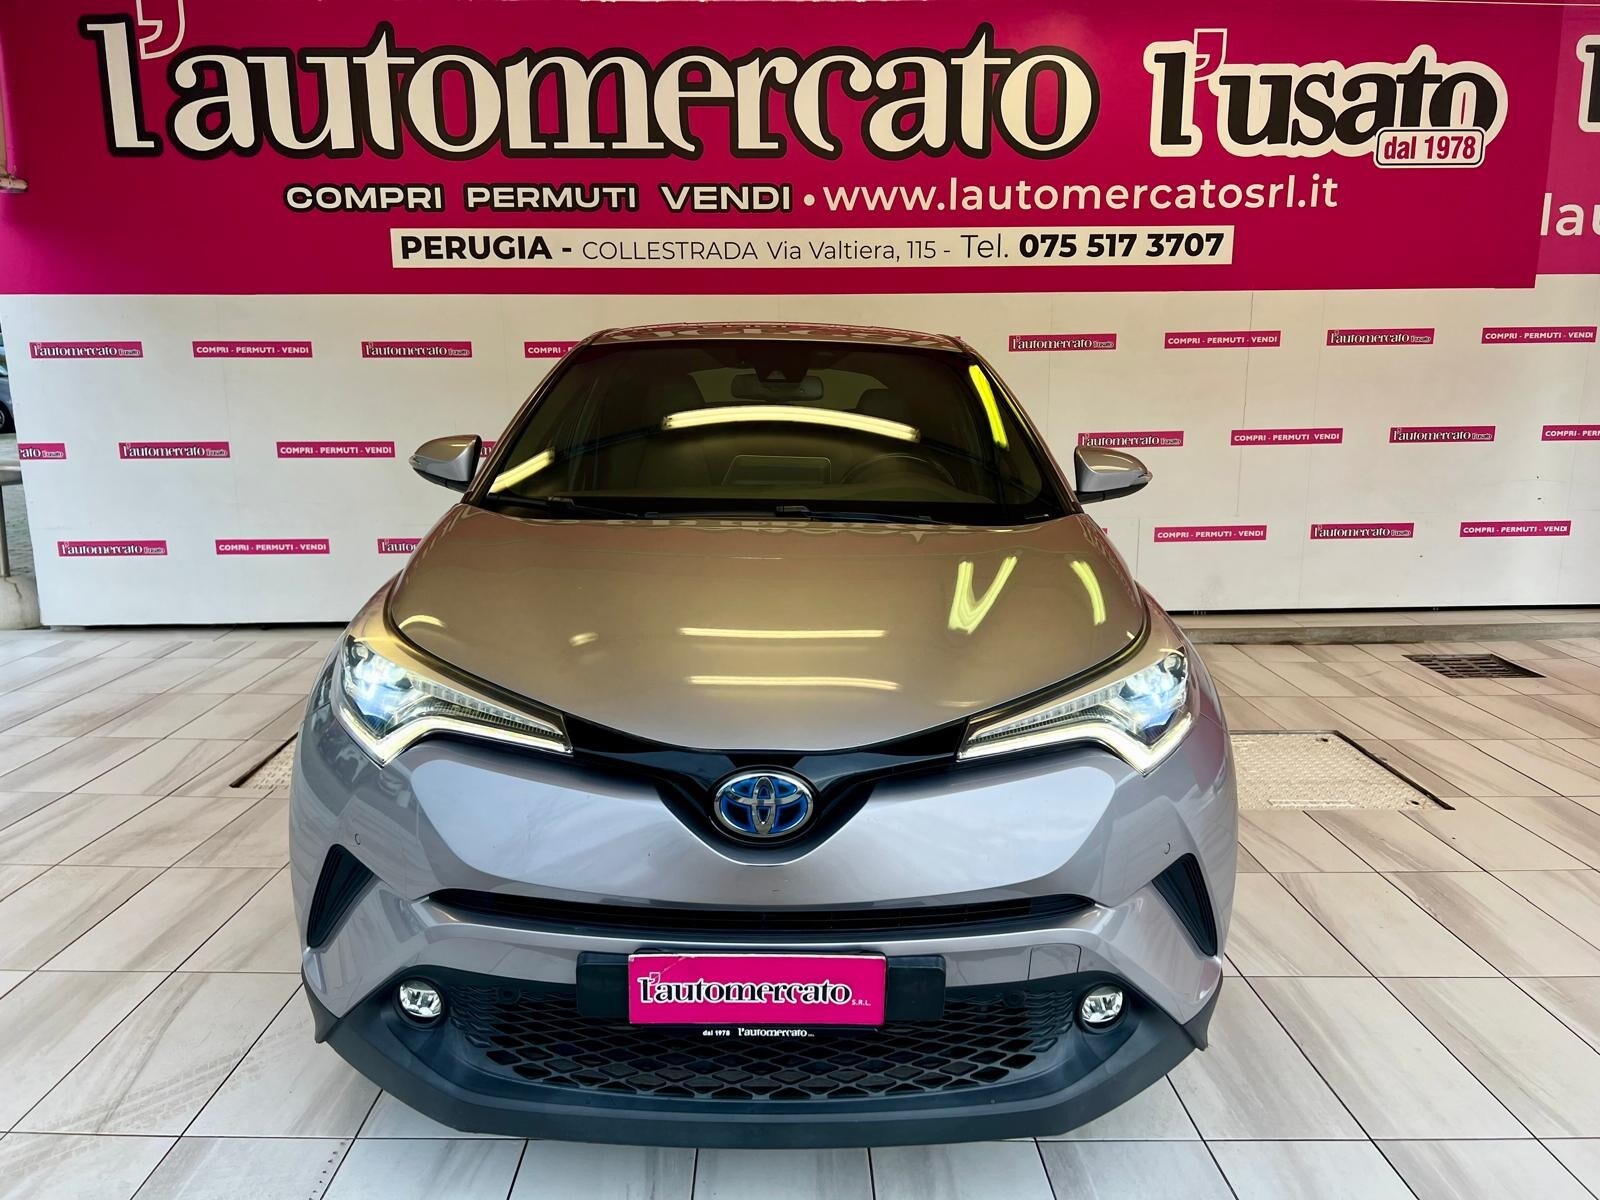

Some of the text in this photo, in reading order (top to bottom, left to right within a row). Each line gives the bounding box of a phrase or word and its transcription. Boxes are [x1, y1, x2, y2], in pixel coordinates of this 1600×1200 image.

[84, 0, 1095, 155] l'automercato
[1153, 28, 1499, 147] l'usato
[1383, 133, 1477, 160] dal 1978
[286, 185, 791, 211] COMPRI PERMUTI VENDI
[822, 174, 1339, 212] www.lautomercatosrl.it
[1540, 192, 1600, 237] la
[400, 235, 552, 260] PERUGIA
[582, 240, 758, 261] COLLESTRADA
[766, 240, 802, 261] Via
[808, 239, 901, 264] Valtiera,
[907, 240, 937, 260] 115
[960, 233, 1009, 260] Tel.
[1018, 233, 1078, 259] 075
[1086, 232, 1135, 259] 517
[1145, 231, 1224, 258] 3707
[1012, 335, 1092, 350] l'automercato
[1167, 337, 1201, 345] COMPRI
[1206, 336, 1245, 344] PERMUTI
[1330, 328, 1410, 344] l'automercato
[1484, 332, 1518, 340] COMPRI
[1568, 331, 1594, 339] VENDI
[33, 342, 118, 357] l'automercato
[196, 346, 229, 354] COMPRI
[235, 346, 275, 354] PERMUTI
[281, 346, 309, 354] VENDI
[365, 342, 448, 356] l'automercato
[1081, 432, 1160, 447] l'automercato
[1393, 427, 1471, 441] l'automercato
[122, 442, 206, 457] l'automercato
[280, 446, 313, 454] COMPRI
[320, 446, 359, 454] PERMUTI
[365, 446, 392, 454] VENDI
[1157, 531, 1189, 539] COMPRI
[1195, 530, 1232, 538] PERMUTI
[1313, 524, 1391, 538] l'automercato
[1462, 526, 1495, 534] COMPRI
[61, 540, 143, 555] l'automercato
[255, 543, 294, 551] PERMUTI
[299, 543, 327, 551] VENDI
[637, 972, 853, 1005] l'automercato
[702, 1029, 714, 1037] dal
[715, 1029, 731, 1037] 1978
[737, 1027, 808, 1038] l'automercato
